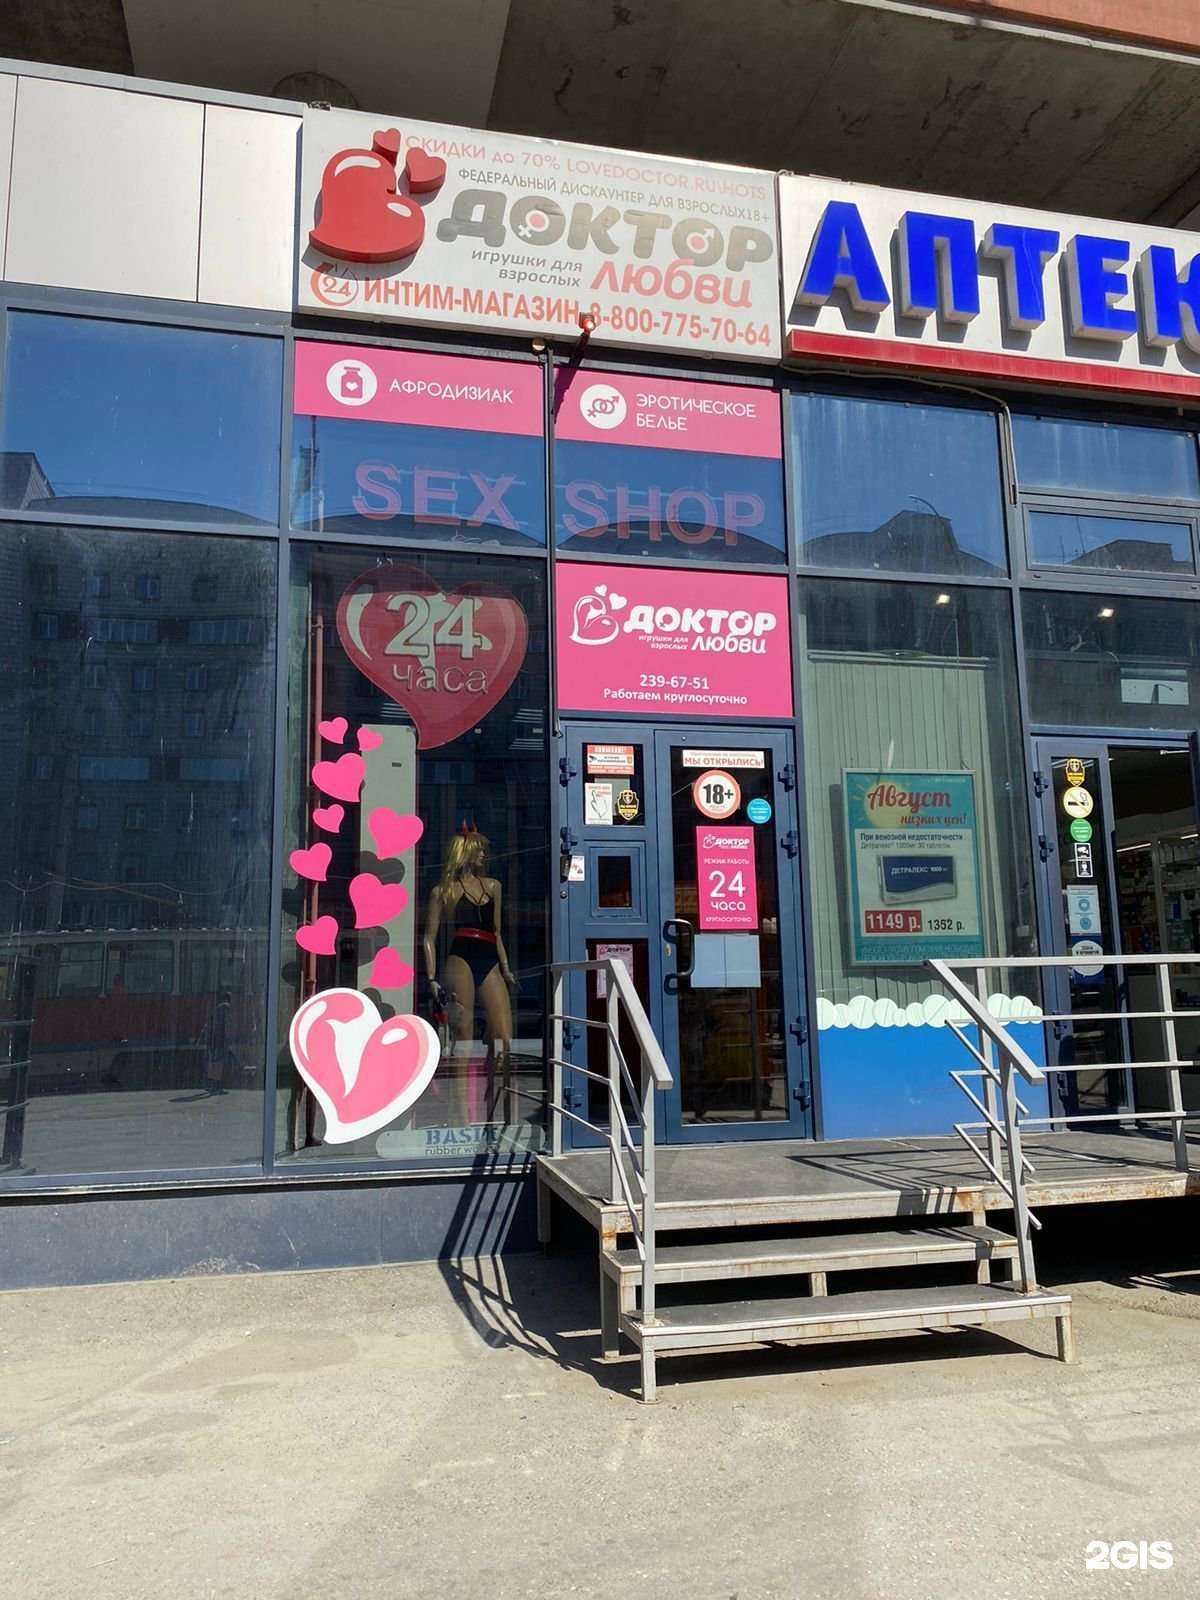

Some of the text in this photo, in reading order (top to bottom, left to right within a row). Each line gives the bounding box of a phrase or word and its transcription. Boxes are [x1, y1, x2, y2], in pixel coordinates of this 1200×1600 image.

[406, 135, 486, 160] СКИДКИ
[521, 151, 561, 170] 70%
[458, 167, 557, 192] ФЕДЕРАЛЬНЫЙ
[560, 180, 645, 204] ДИСКАУНТЕР
[648, 194, 674, 209] ДЛЯ
[436, 188, 774, 273] ДОКТОР
[471, 249, 583, 273] игрушки для
[498, 267, 582, 287] взрослых
[364, 276, 771, 346] ИНТИМ-МАГАЗИН 8-800-775-70-64
[389, 379, 513, 405] АФРОДИЗИАК
[636, 393, 757, 419] ЭРОТИЧЕСКОЕ
[636, 413, 688, 432] БЕЛЬЕ
[352, 461, 765, 547] SEX SHOP
[384, 592, 484, 659] 24
[623, 604, 777, 636] ДОКТОР
[391, 663, 489, 695] часа
[639, 673, 710, 690] 239-67-51
[604, 688, 748, 706] Работаем круглосуточно
[684, 757, 701, 766] МЫ
[703, 783, 734, 805] 18+
[867, 783, 952, 814] Август
[860, 832, 963, 841] При венозной недостаточности
[708, 870, 747, 898] 24
[711, 901, 746, 912] часа
[866, 912, 965, 932] 1149 р. 1352 р.
